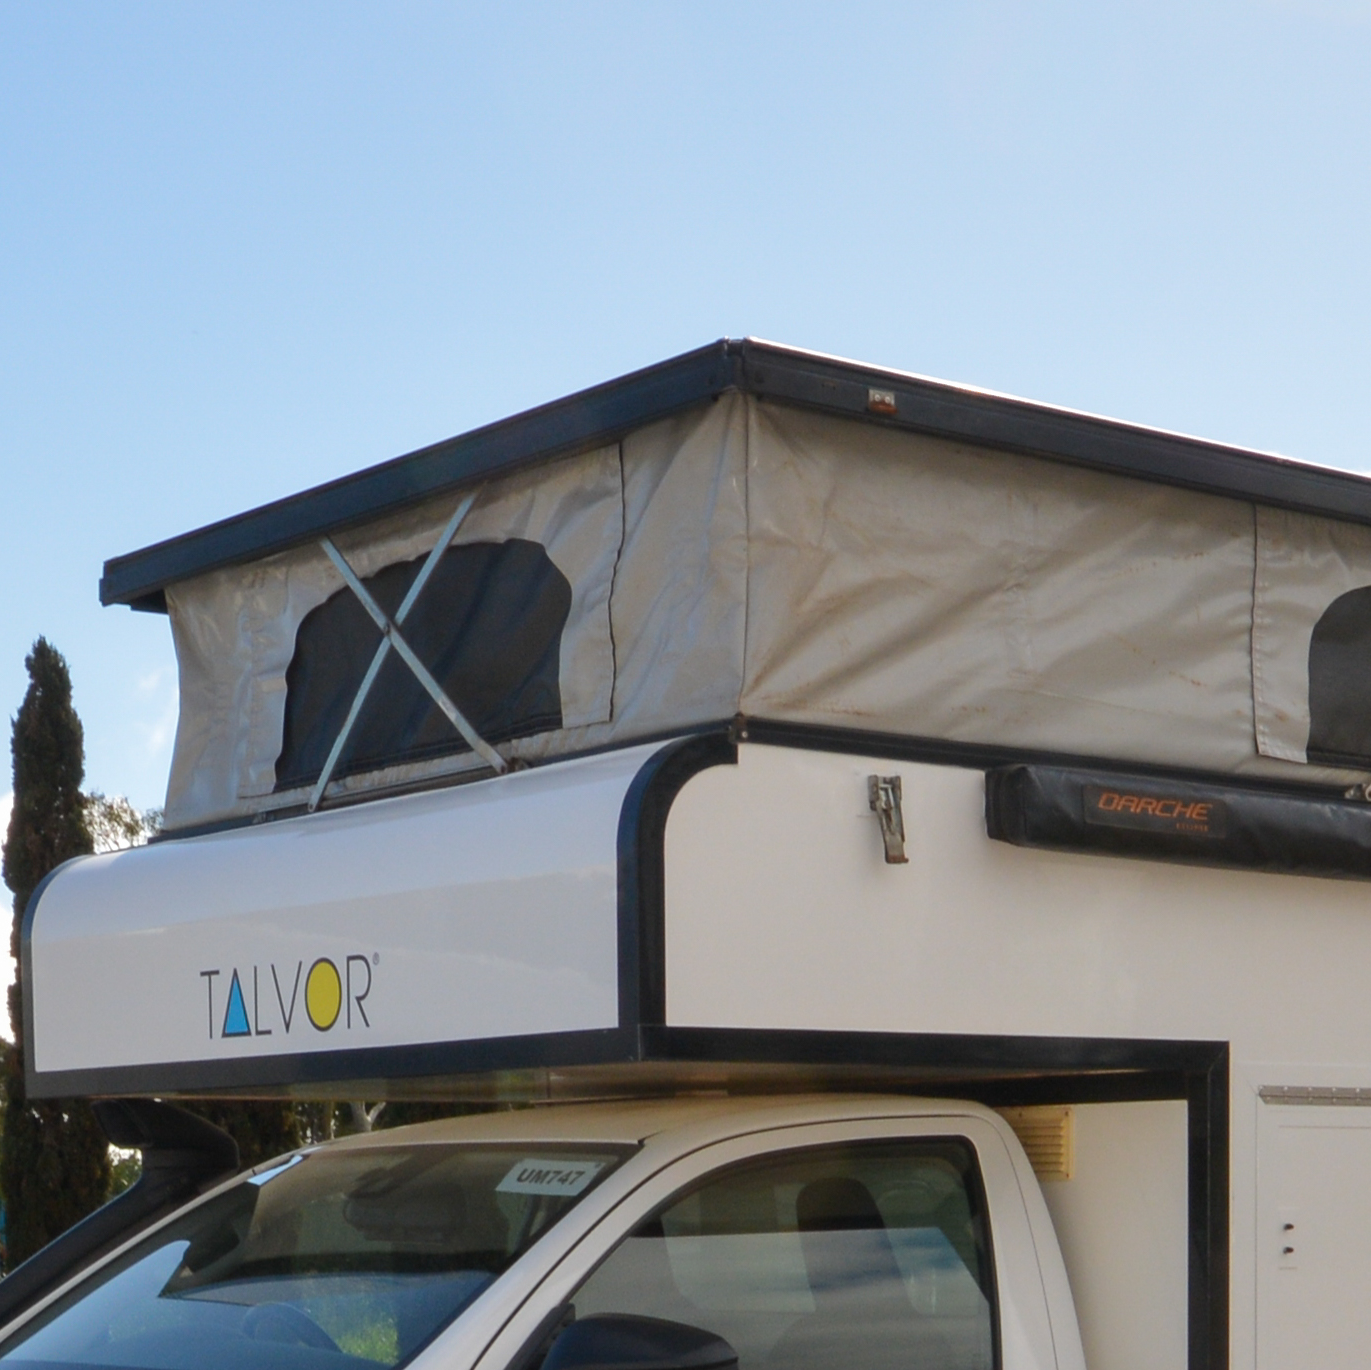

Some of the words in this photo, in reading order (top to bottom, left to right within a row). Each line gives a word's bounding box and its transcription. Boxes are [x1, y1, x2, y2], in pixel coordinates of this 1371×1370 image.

[1097, 791, 1213, 821] DARCHE
[199, 954, 372, 1040] TALVOR
[516, 1167, 586, 1185] UM747
